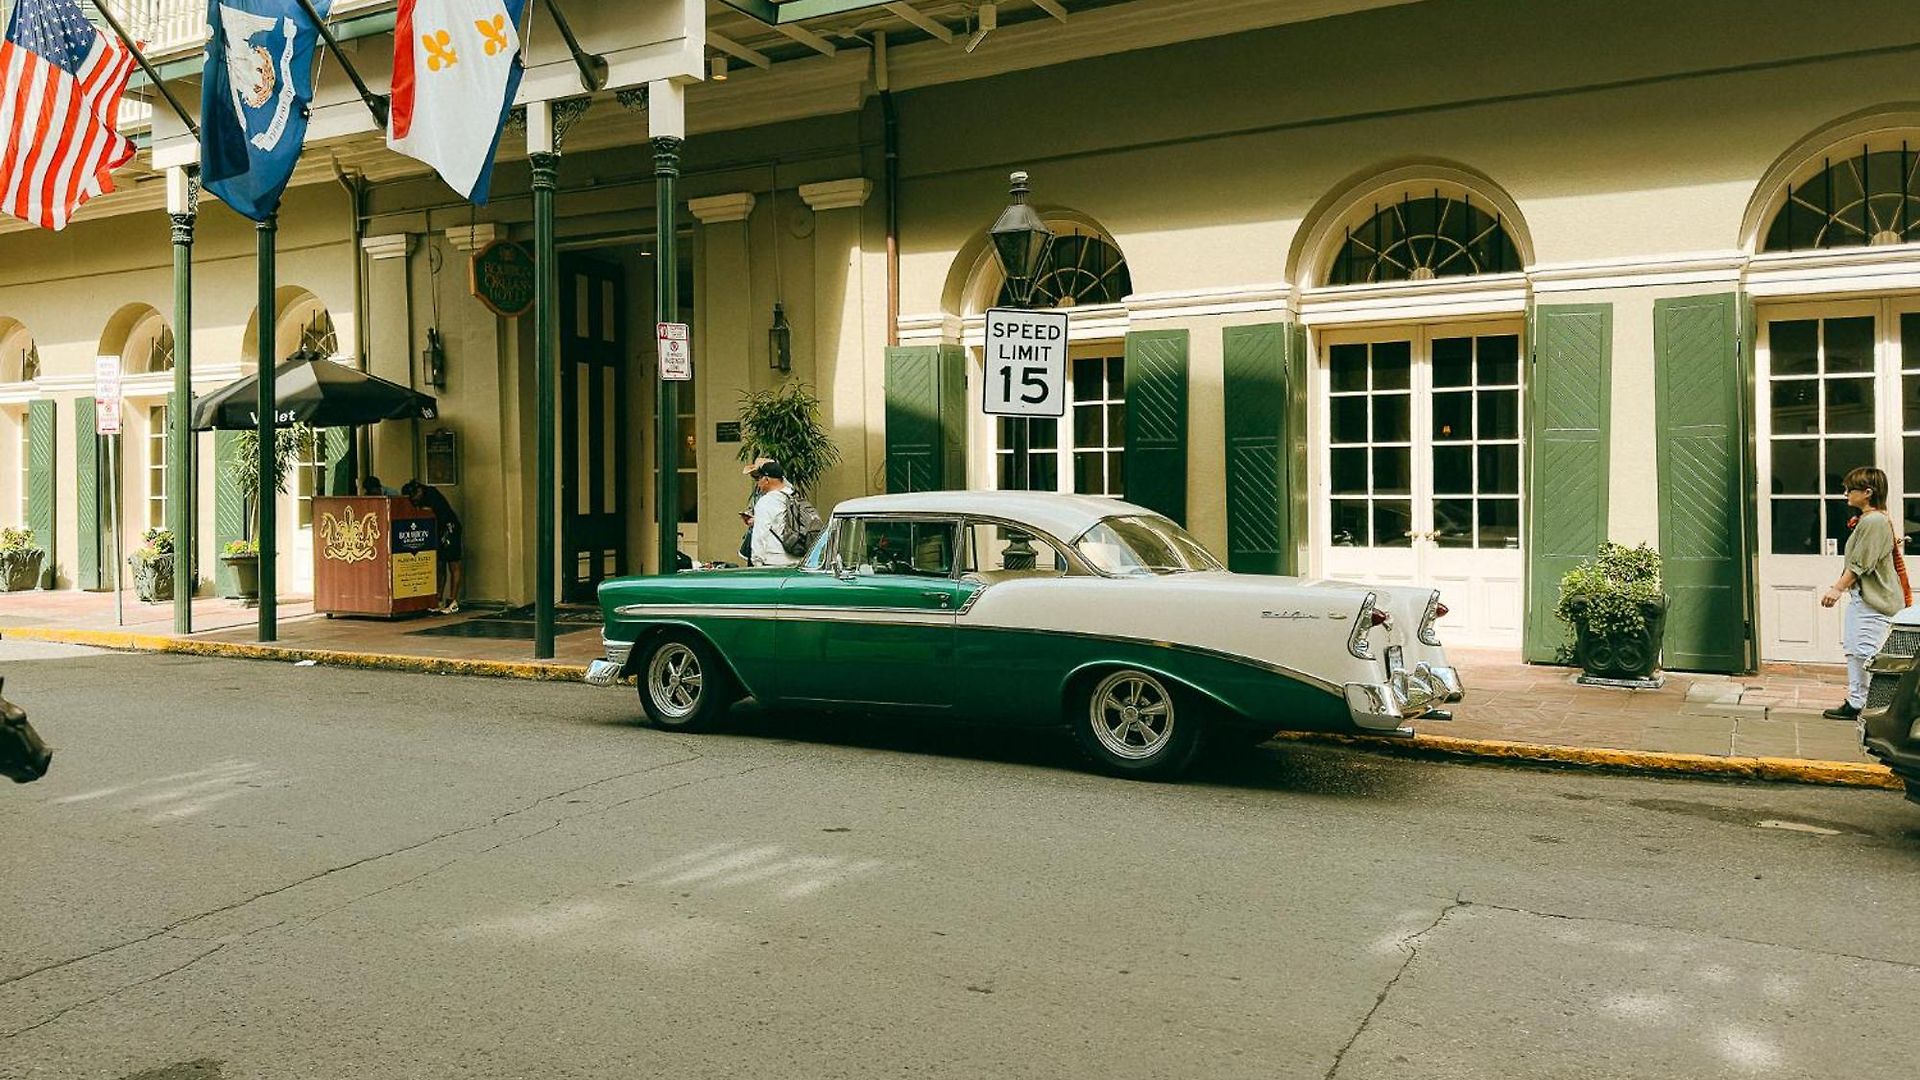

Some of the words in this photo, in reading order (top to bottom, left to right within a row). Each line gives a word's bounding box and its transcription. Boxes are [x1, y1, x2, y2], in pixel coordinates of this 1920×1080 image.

[993, 322, 1060, 340] SPEED
[999, 344, 1052, 362] LIMIT
[999, 366, 1049, 404] 15
[250, 409, 296, 425] Vlet
